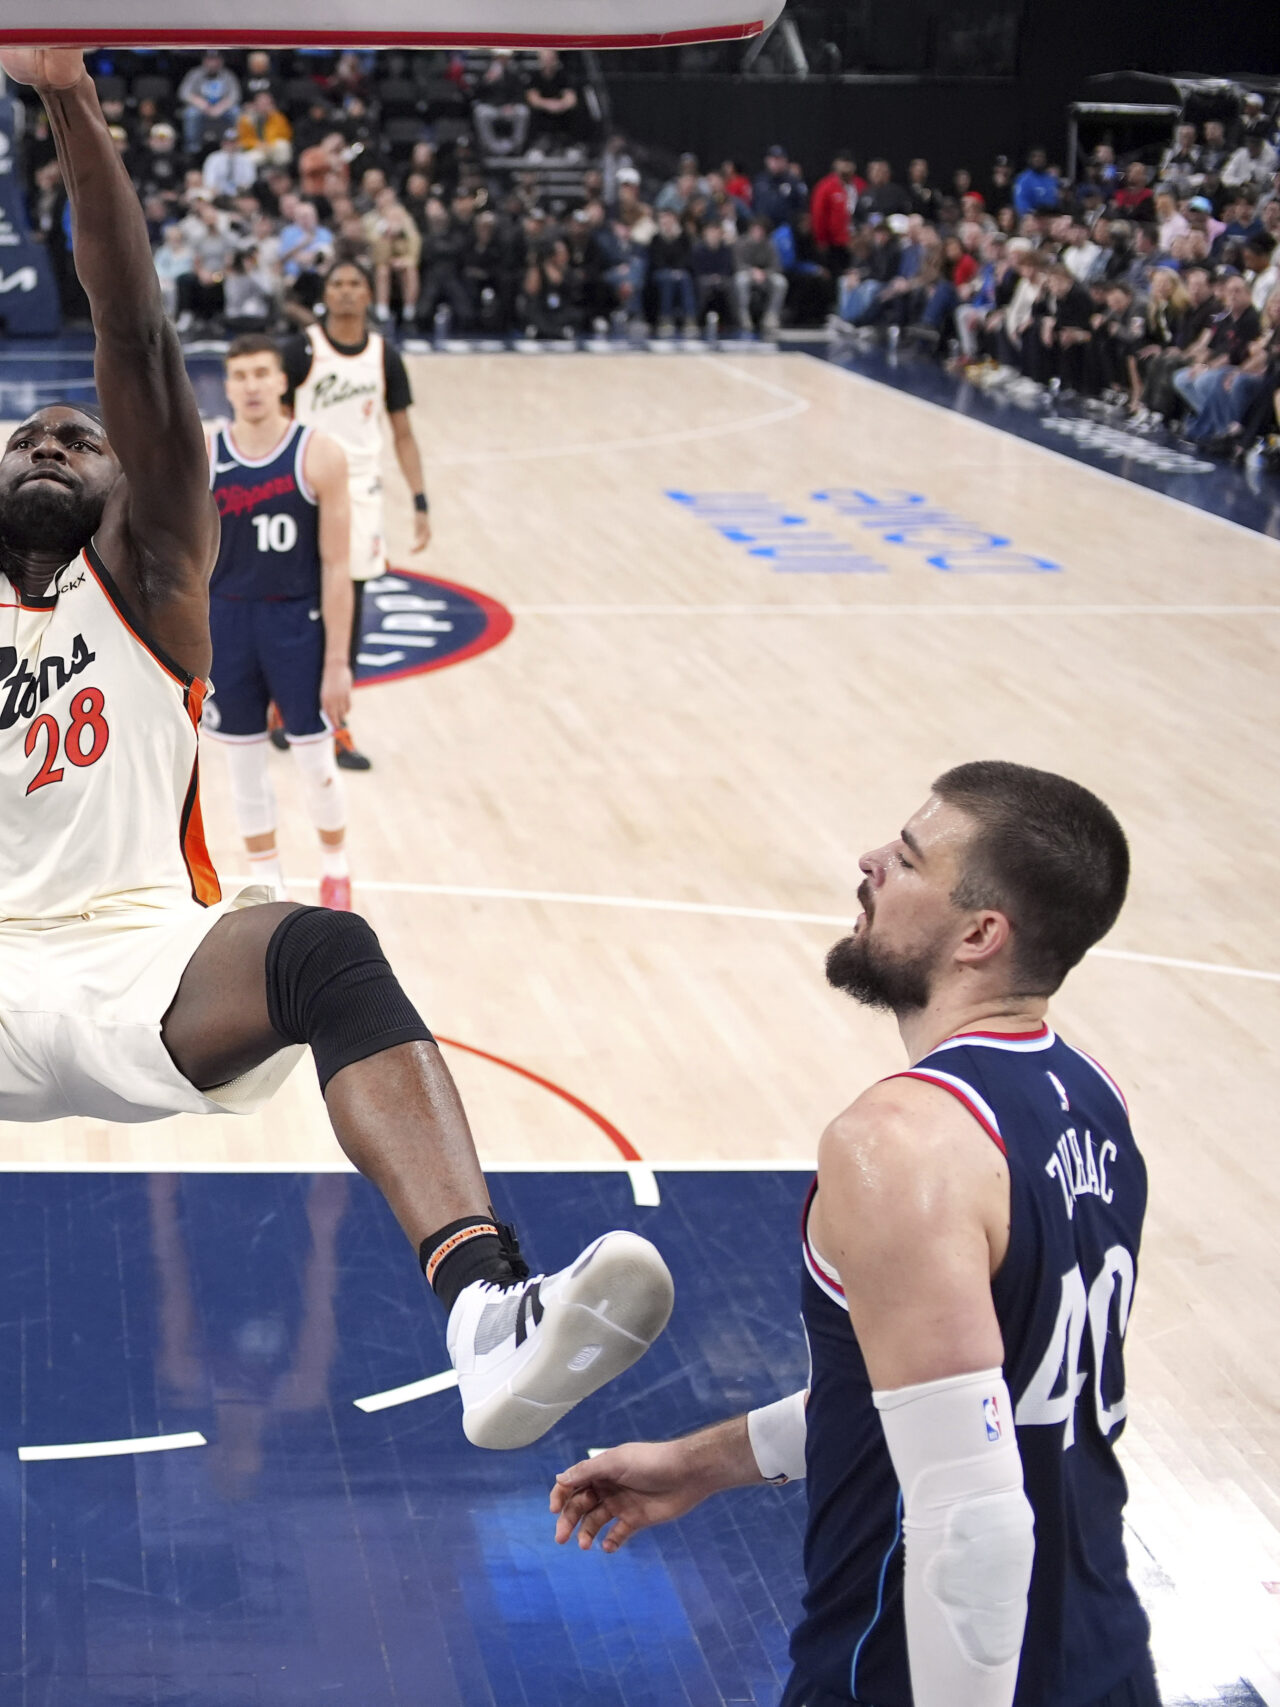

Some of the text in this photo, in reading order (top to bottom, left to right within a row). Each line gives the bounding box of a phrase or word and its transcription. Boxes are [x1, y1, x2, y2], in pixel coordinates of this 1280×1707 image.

[252, 513, 298, 552] 10
[24, 686, 110, 797] 28
[1015, 1245, 1138, 1451] 40
